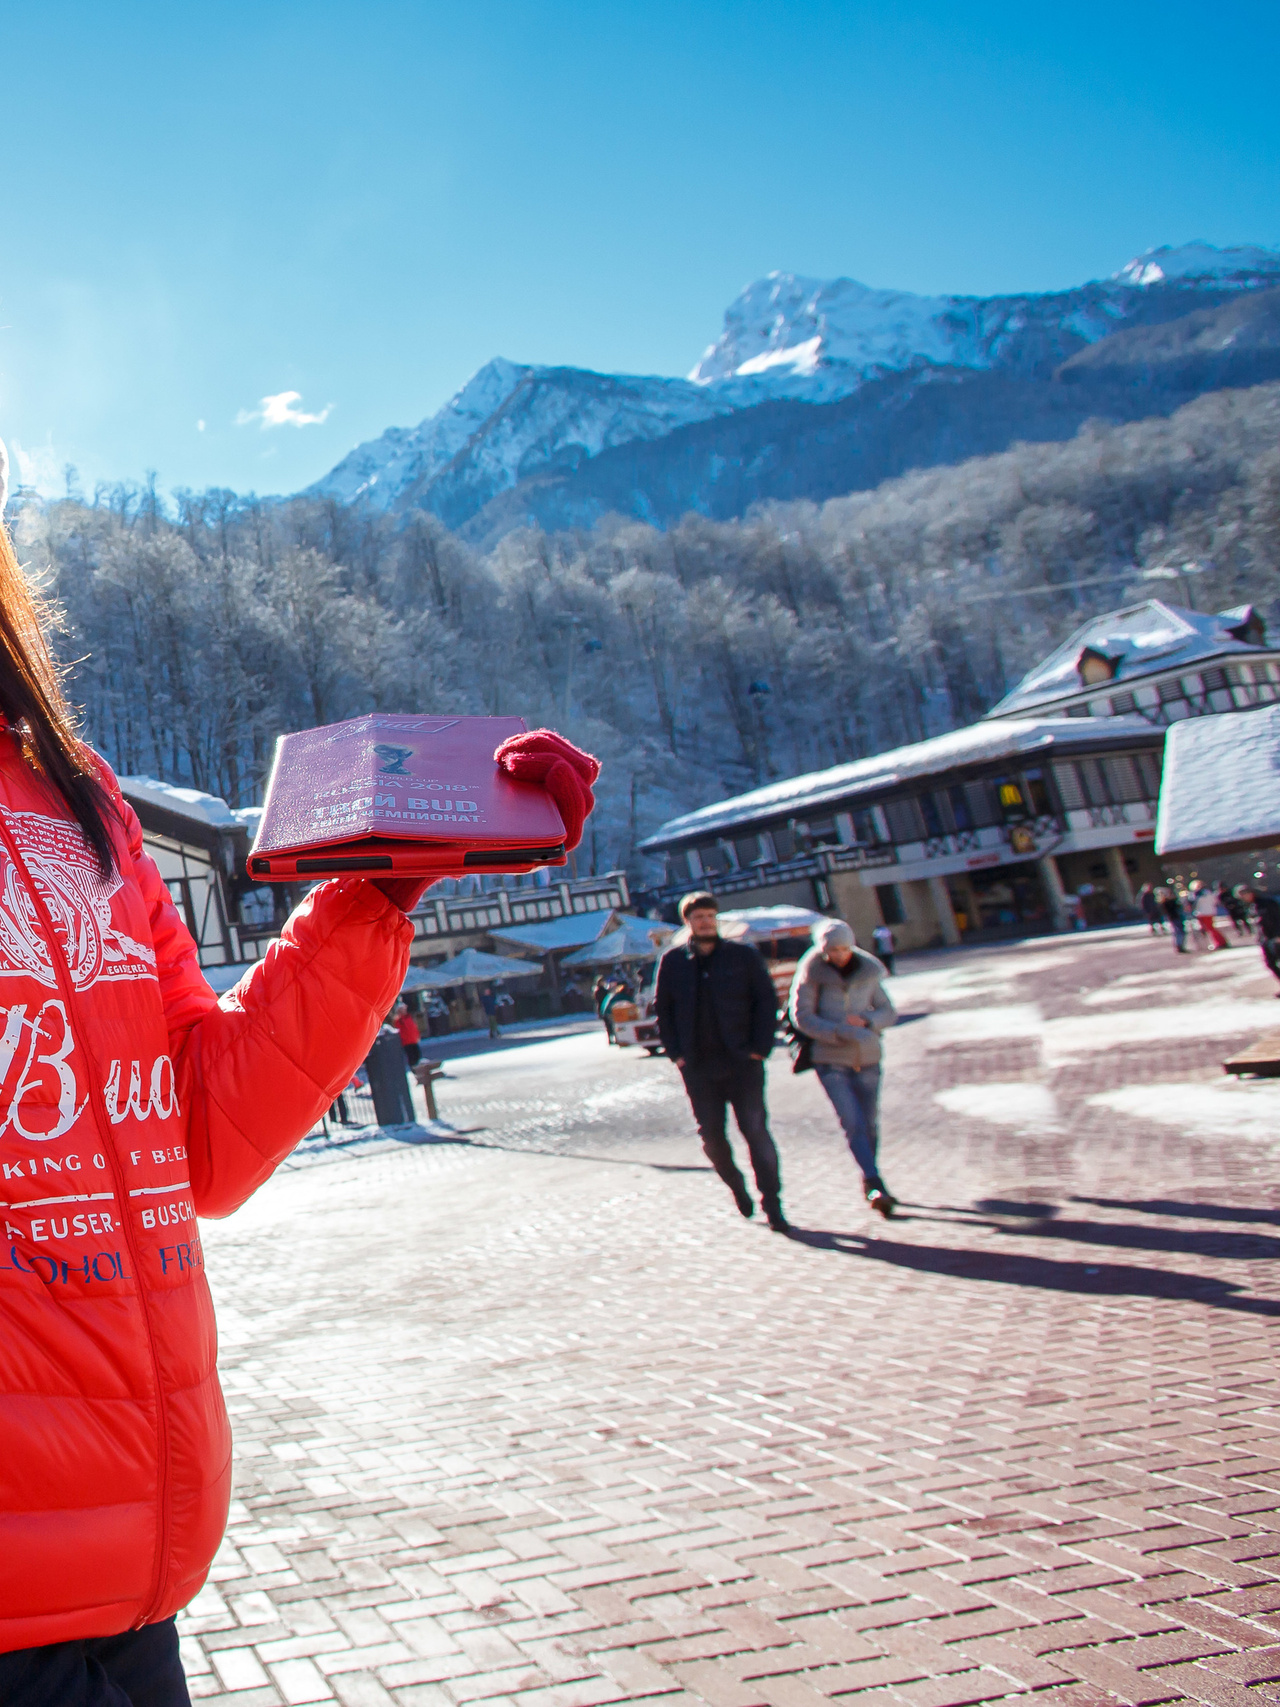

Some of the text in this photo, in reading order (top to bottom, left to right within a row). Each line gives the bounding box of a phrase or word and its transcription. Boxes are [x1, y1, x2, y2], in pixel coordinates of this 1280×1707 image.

[373, 774, 413, 782] WORLD
[408, 797, 485, 813] BUD.
[2, 1154, 82, 1180] KING
[159, 1238, 202, 1275] FREE
